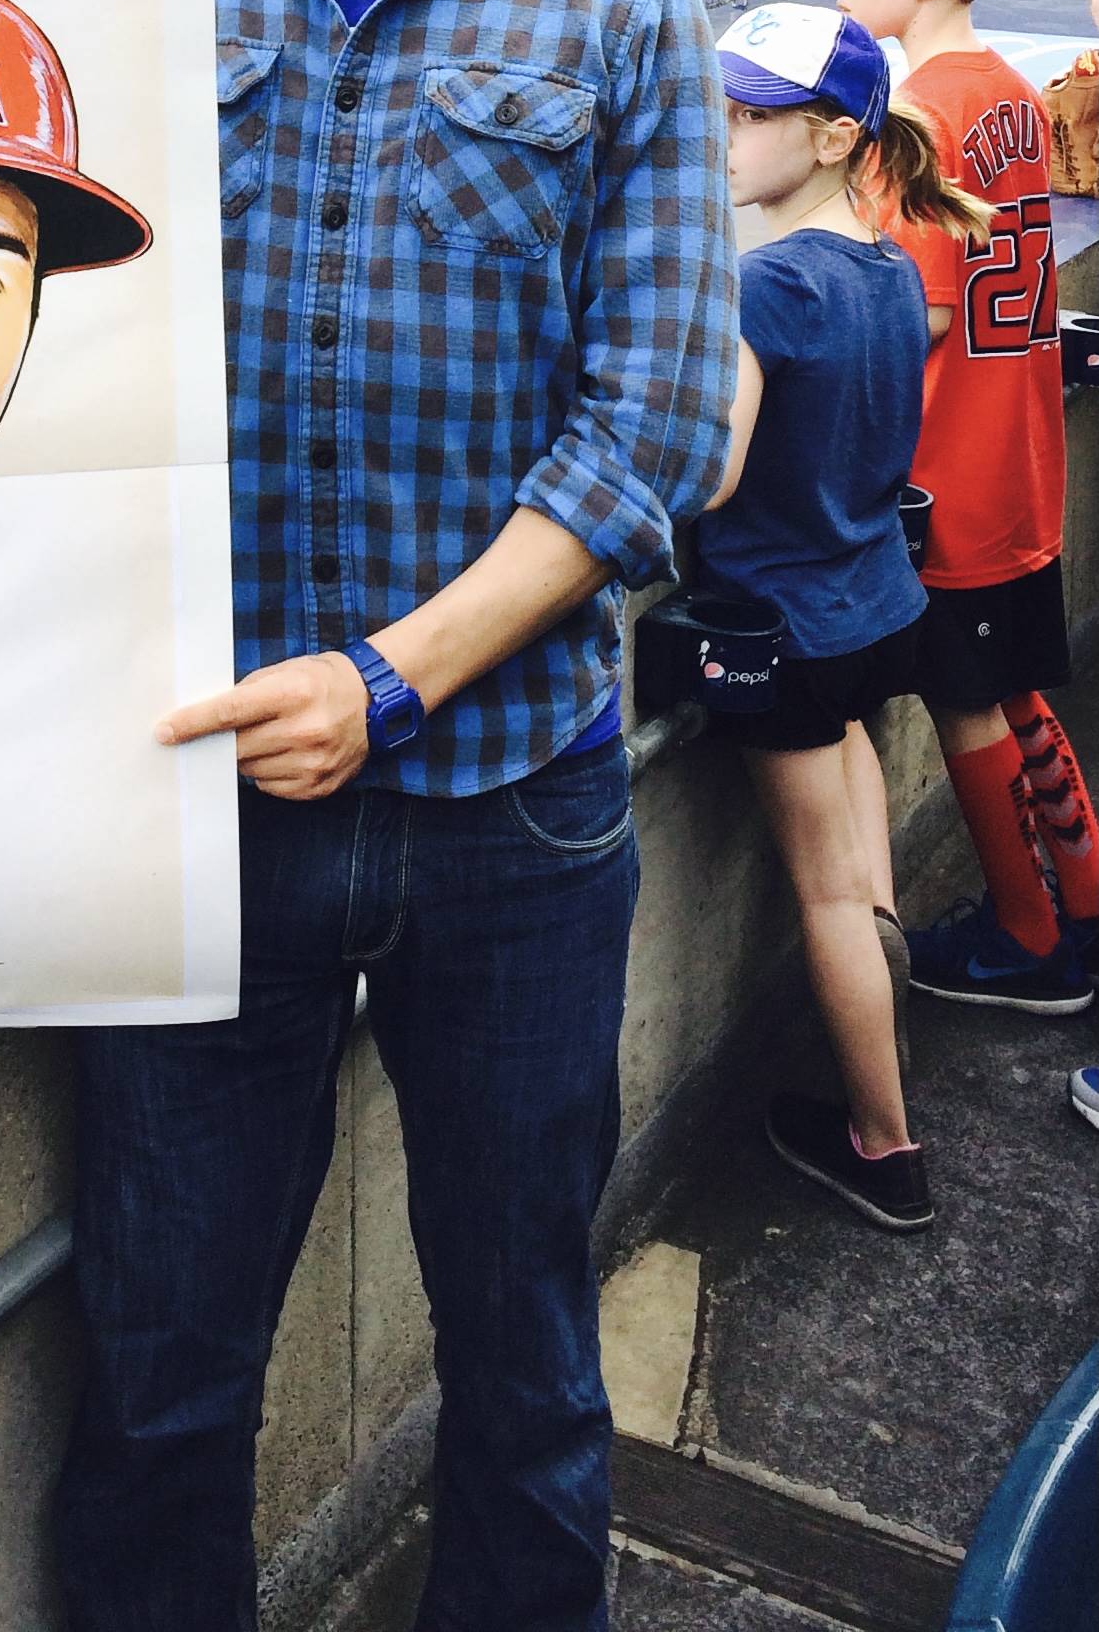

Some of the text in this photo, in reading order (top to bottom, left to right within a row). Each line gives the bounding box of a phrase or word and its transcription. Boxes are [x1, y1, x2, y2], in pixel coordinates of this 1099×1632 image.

[962, 99, 1047, 189] TROU
[963, 193, 1061, 358] 27
[728, 668, 770, 686] pepsi
